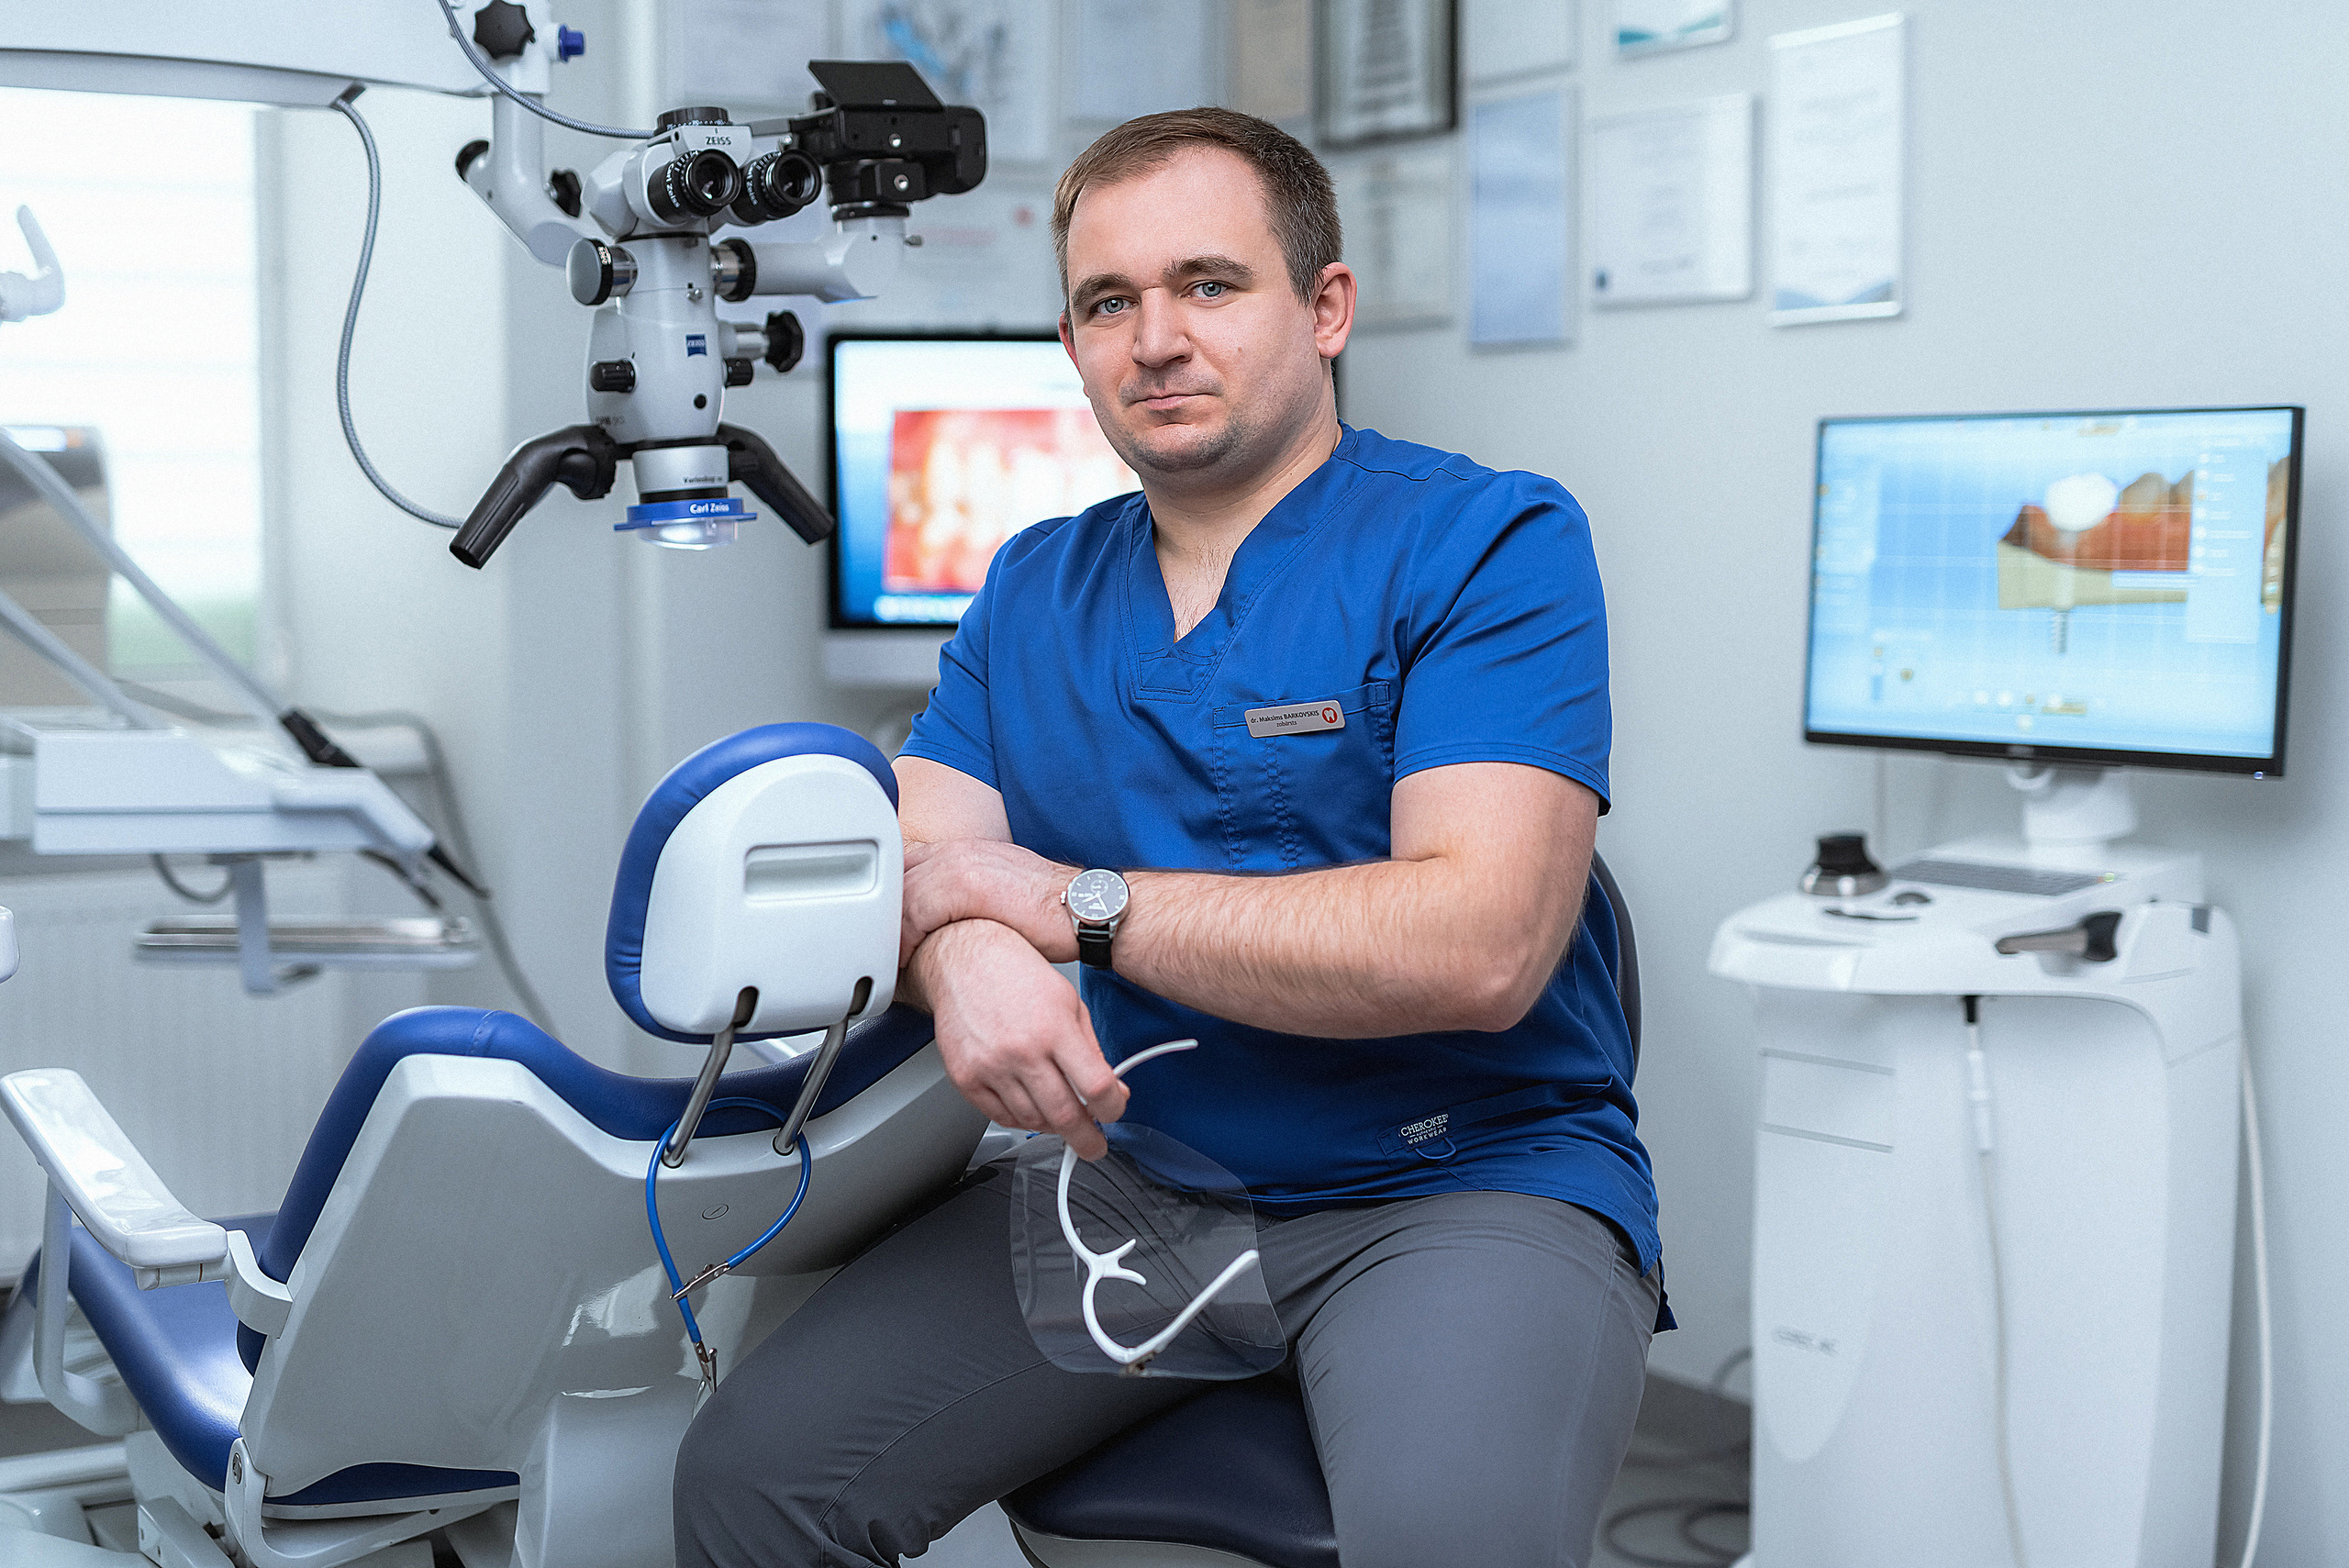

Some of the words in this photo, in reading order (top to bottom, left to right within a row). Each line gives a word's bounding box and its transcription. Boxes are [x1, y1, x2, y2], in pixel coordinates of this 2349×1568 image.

[706, 136, 732, 146] ZEISS
[666, 162, 674, 183] Carl
[666, 183, 681, 208] Zeiss
[689, 503, 709, 515] Carl
[710, 502, 729, 513] Zeiss
[1259, 714, 1283, 723] Maksims
[1283, 710, 1319, 720] BARKOVSKIS
[1407, 1127, 1447, 1145] WORKWEAR
